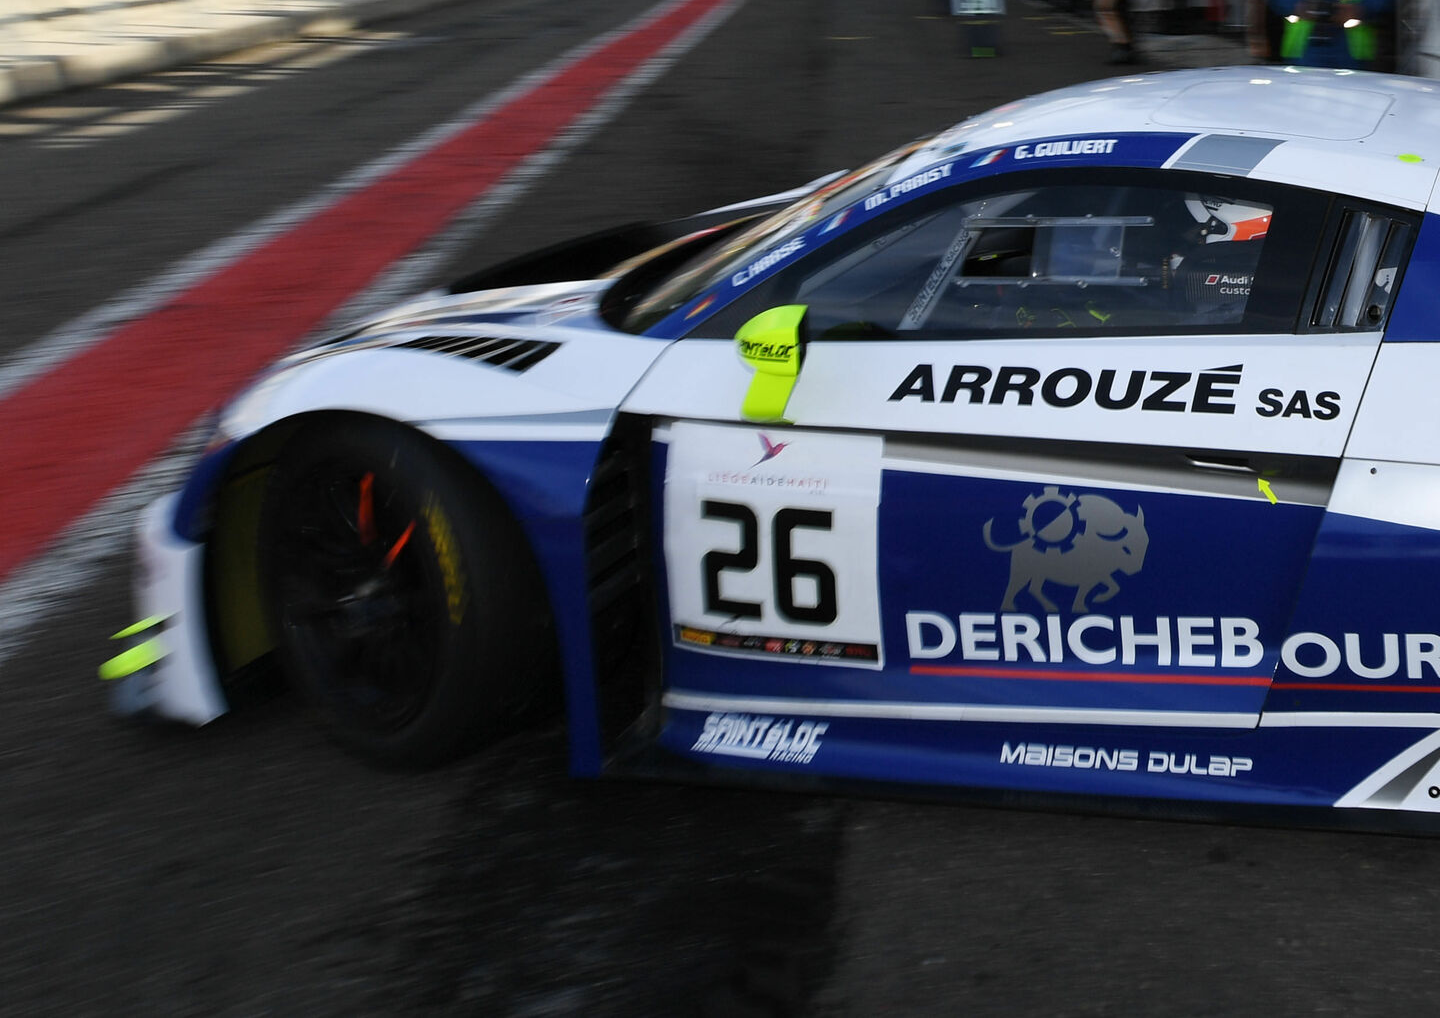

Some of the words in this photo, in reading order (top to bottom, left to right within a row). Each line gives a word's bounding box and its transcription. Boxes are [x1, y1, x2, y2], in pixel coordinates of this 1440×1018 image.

[1220, 275, 1248, 285] Audi
[886, 363, 1244, 414] ARROUZÉ
[1255, 388, 1340, 420] SAS
[700, 500, 838, 625] 26
[1000, 741, 1138, 771] MAISONS
[1147, 750, 1253, 777] DULAP
